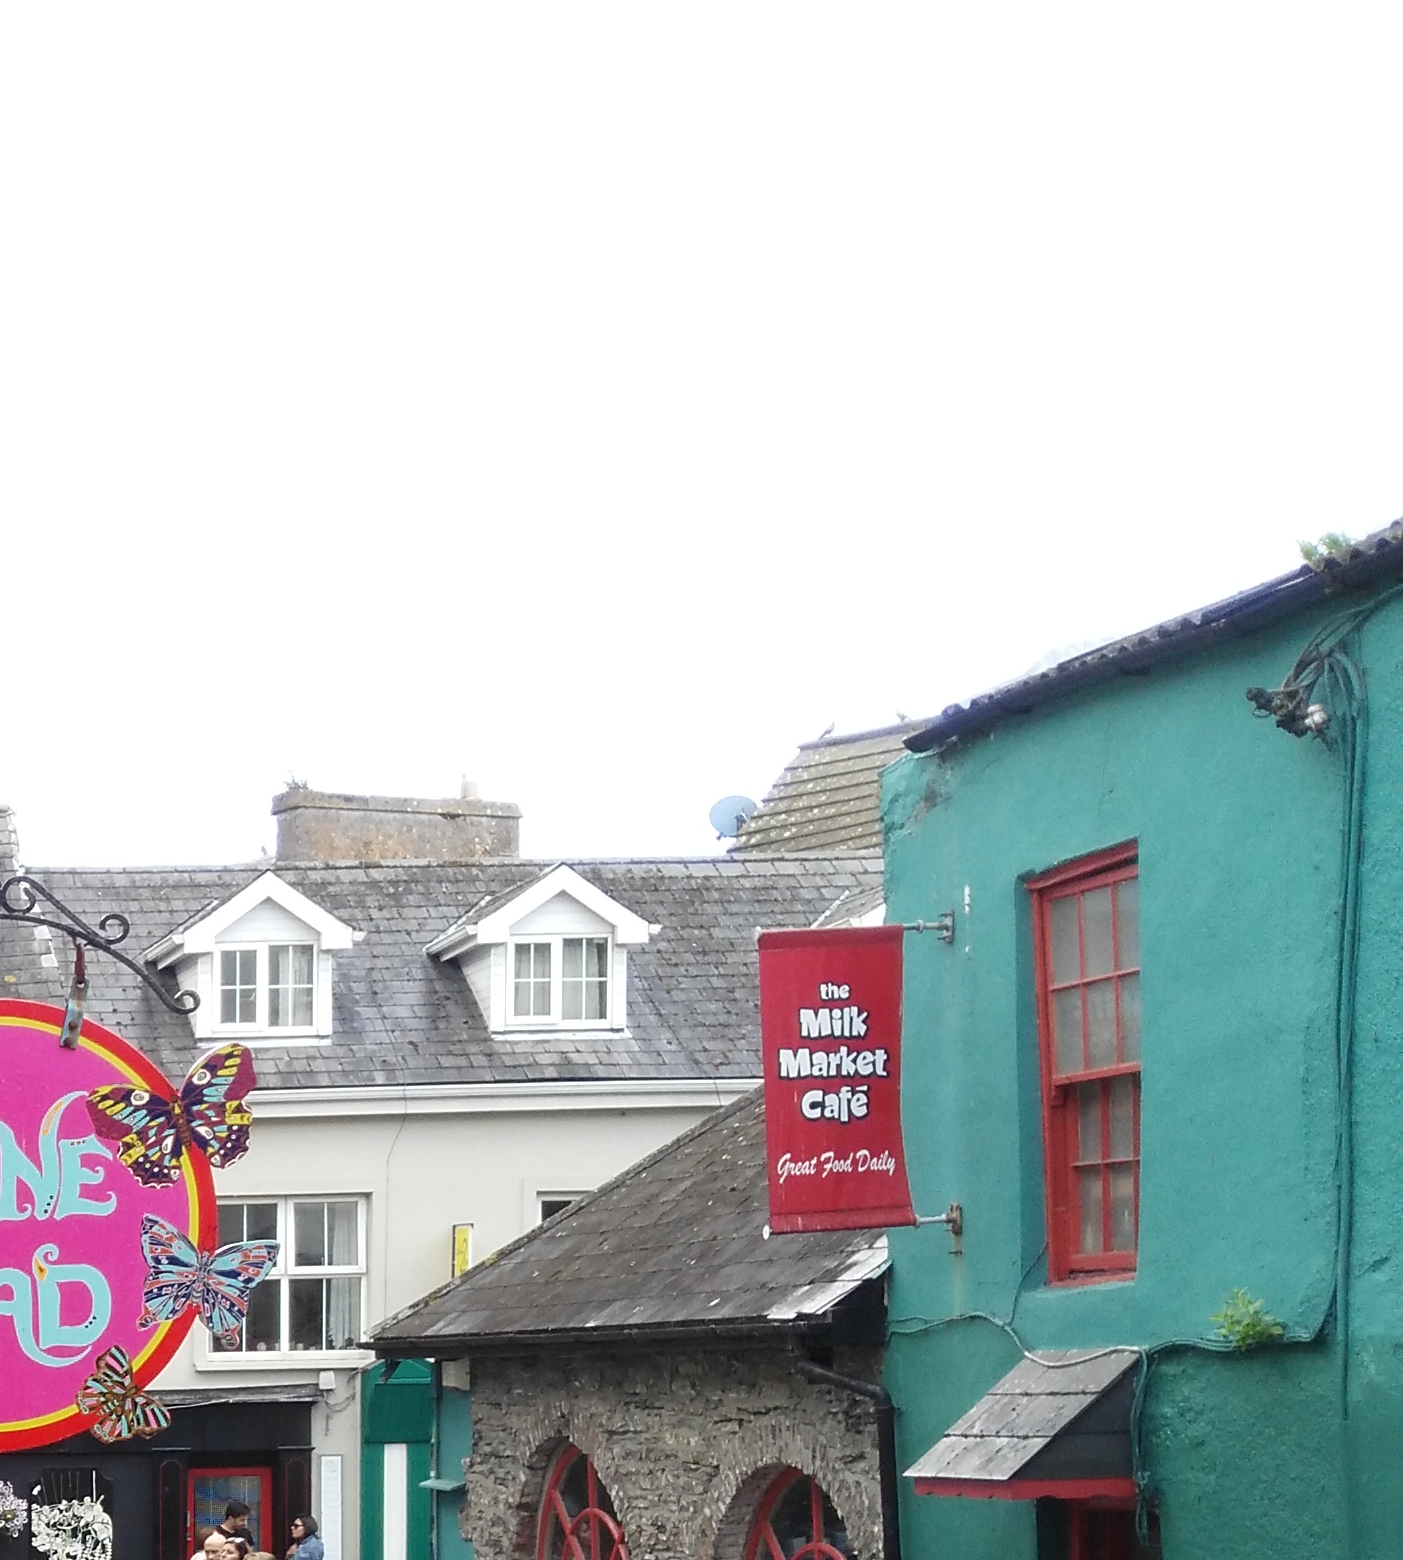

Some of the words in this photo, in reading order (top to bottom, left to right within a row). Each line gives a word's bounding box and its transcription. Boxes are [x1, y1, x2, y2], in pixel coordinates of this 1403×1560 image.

[819, 982, 850, 1000] the
[799, 1007, 868, 1039] Milk
[779, 1046, 888, 1079] Market
[800, 1085, 869, 1122] Café
[777, 1152, 817, 1183] Great
[822, 1151, 853, 1179] Food
[856, 1150, 895, 1176] Daily
